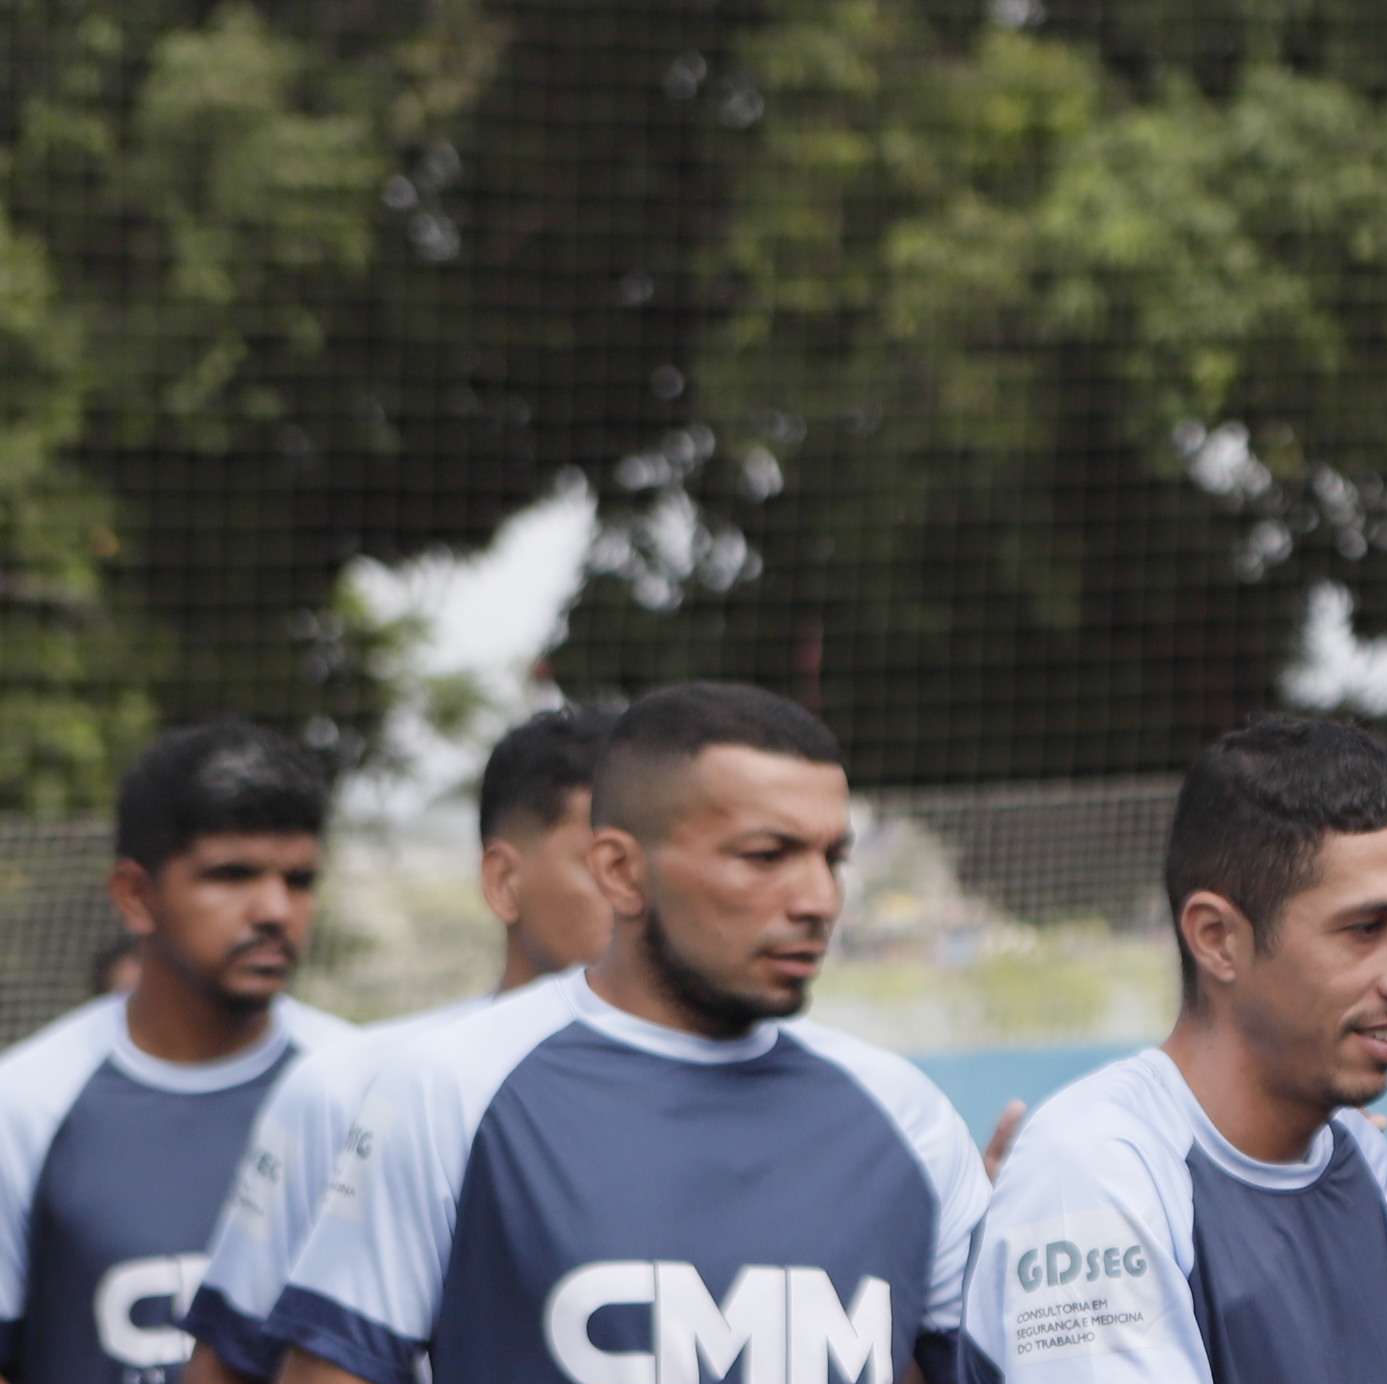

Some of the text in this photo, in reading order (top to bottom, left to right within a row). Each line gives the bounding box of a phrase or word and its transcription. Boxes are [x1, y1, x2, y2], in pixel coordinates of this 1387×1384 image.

[1016, 1298, 1109, 1325] CONSULTORIA EM
[1016, 1311, 1145, 1341] SEGURANÇA E MEDICINA
[1016, 1331, 1096, 1356] DO TRABALHO
